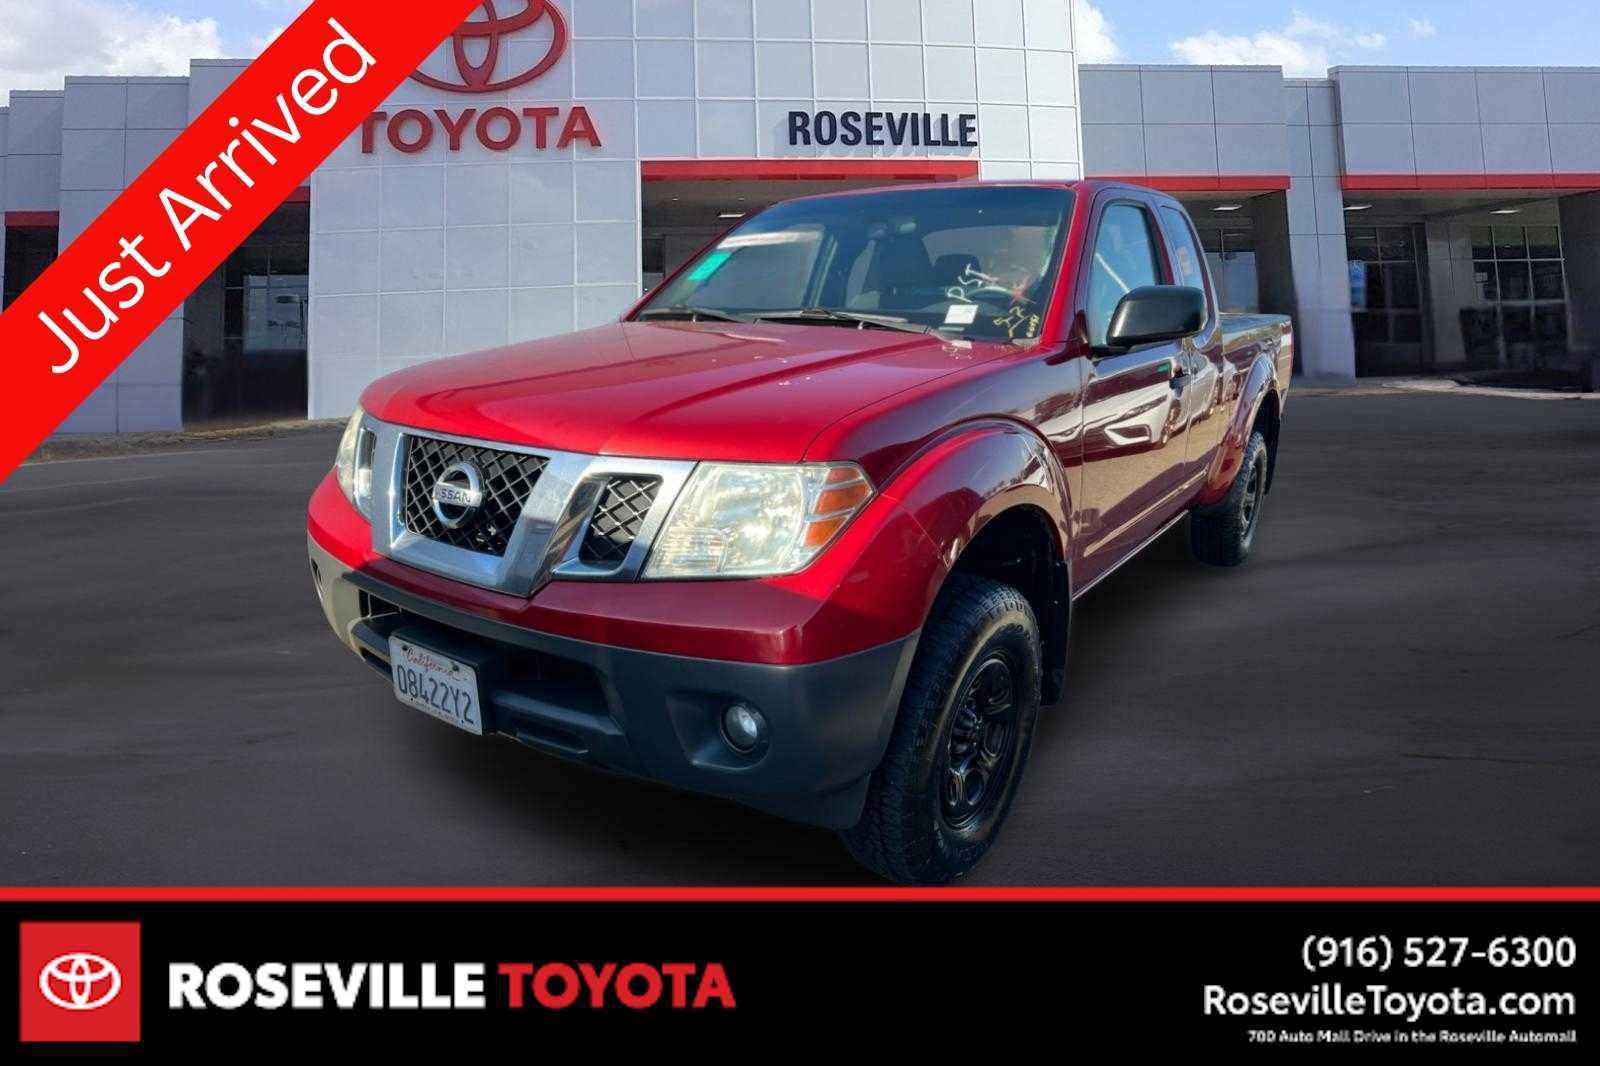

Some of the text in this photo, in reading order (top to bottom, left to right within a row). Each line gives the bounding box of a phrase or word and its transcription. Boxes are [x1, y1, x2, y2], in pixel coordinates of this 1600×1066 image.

[361, 106, 602, 154] TOYOTA
[788, 110, 978, 147] ROSEVILLE
[397, 664, 474, 724] 08422Y2
